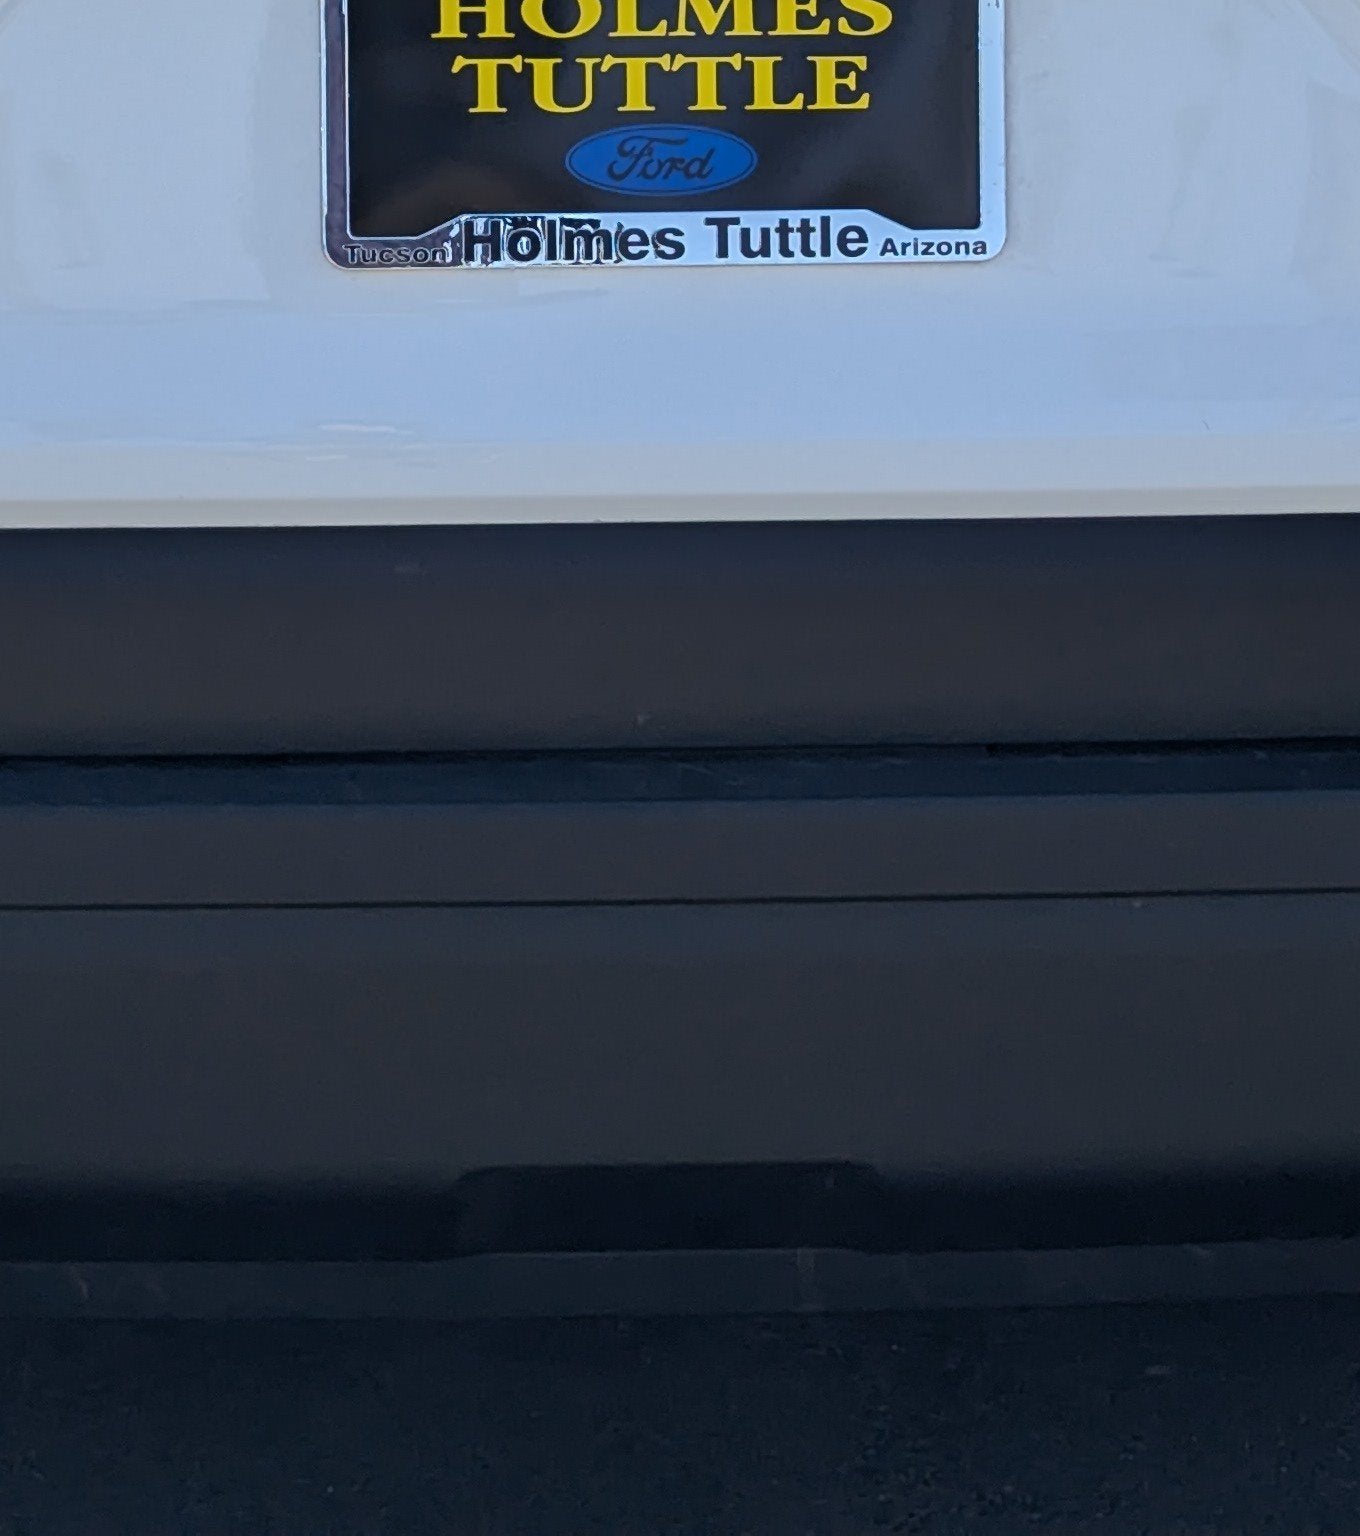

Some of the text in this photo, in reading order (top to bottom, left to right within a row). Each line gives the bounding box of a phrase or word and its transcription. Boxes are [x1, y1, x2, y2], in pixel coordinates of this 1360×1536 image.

[451, 52, 871, 114] TUTTLE
[606, 134, 714, 183] Ford
[342, 215, 988, 264] Tucson Holmes Tuttle Arizona
